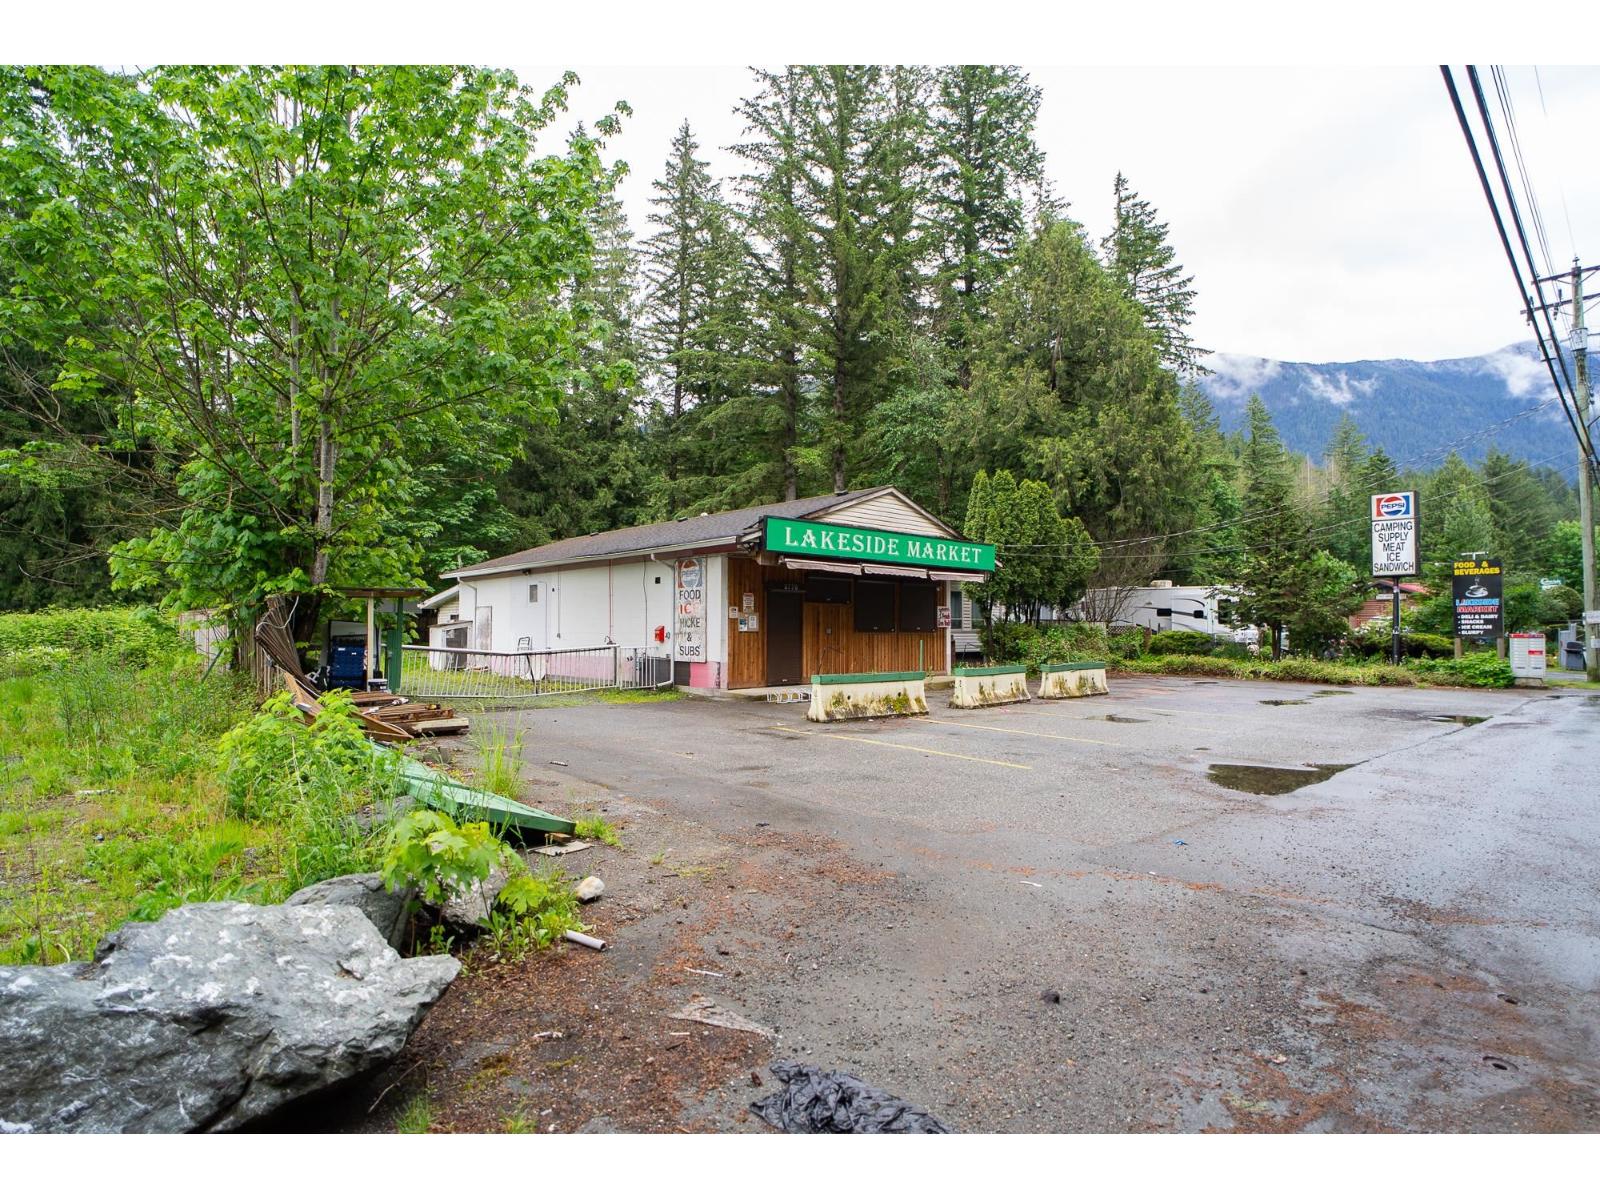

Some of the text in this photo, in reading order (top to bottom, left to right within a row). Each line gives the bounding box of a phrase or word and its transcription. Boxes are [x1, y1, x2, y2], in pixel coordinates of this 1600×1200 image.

[1374, 522, 1413, 533] CAMPING
[1378, 532, 1409, 542] SUPPLY
[784, 526, 982, 564] LAKESIDE MARKET
[1383, 542, 1406, 552] MEAT
[1386, 552, 1401, 562] ICE
[1374, 561, 1414, 572] SANDWICH
[1454, 560, 1489, 569] FOOD &
[1454, 567, 1500, 576] BEVERAGES
[680, 589, 701, 600] FOOD
[686, 632, 693, 642] &
[680, 645, 701, 656] SUBS
